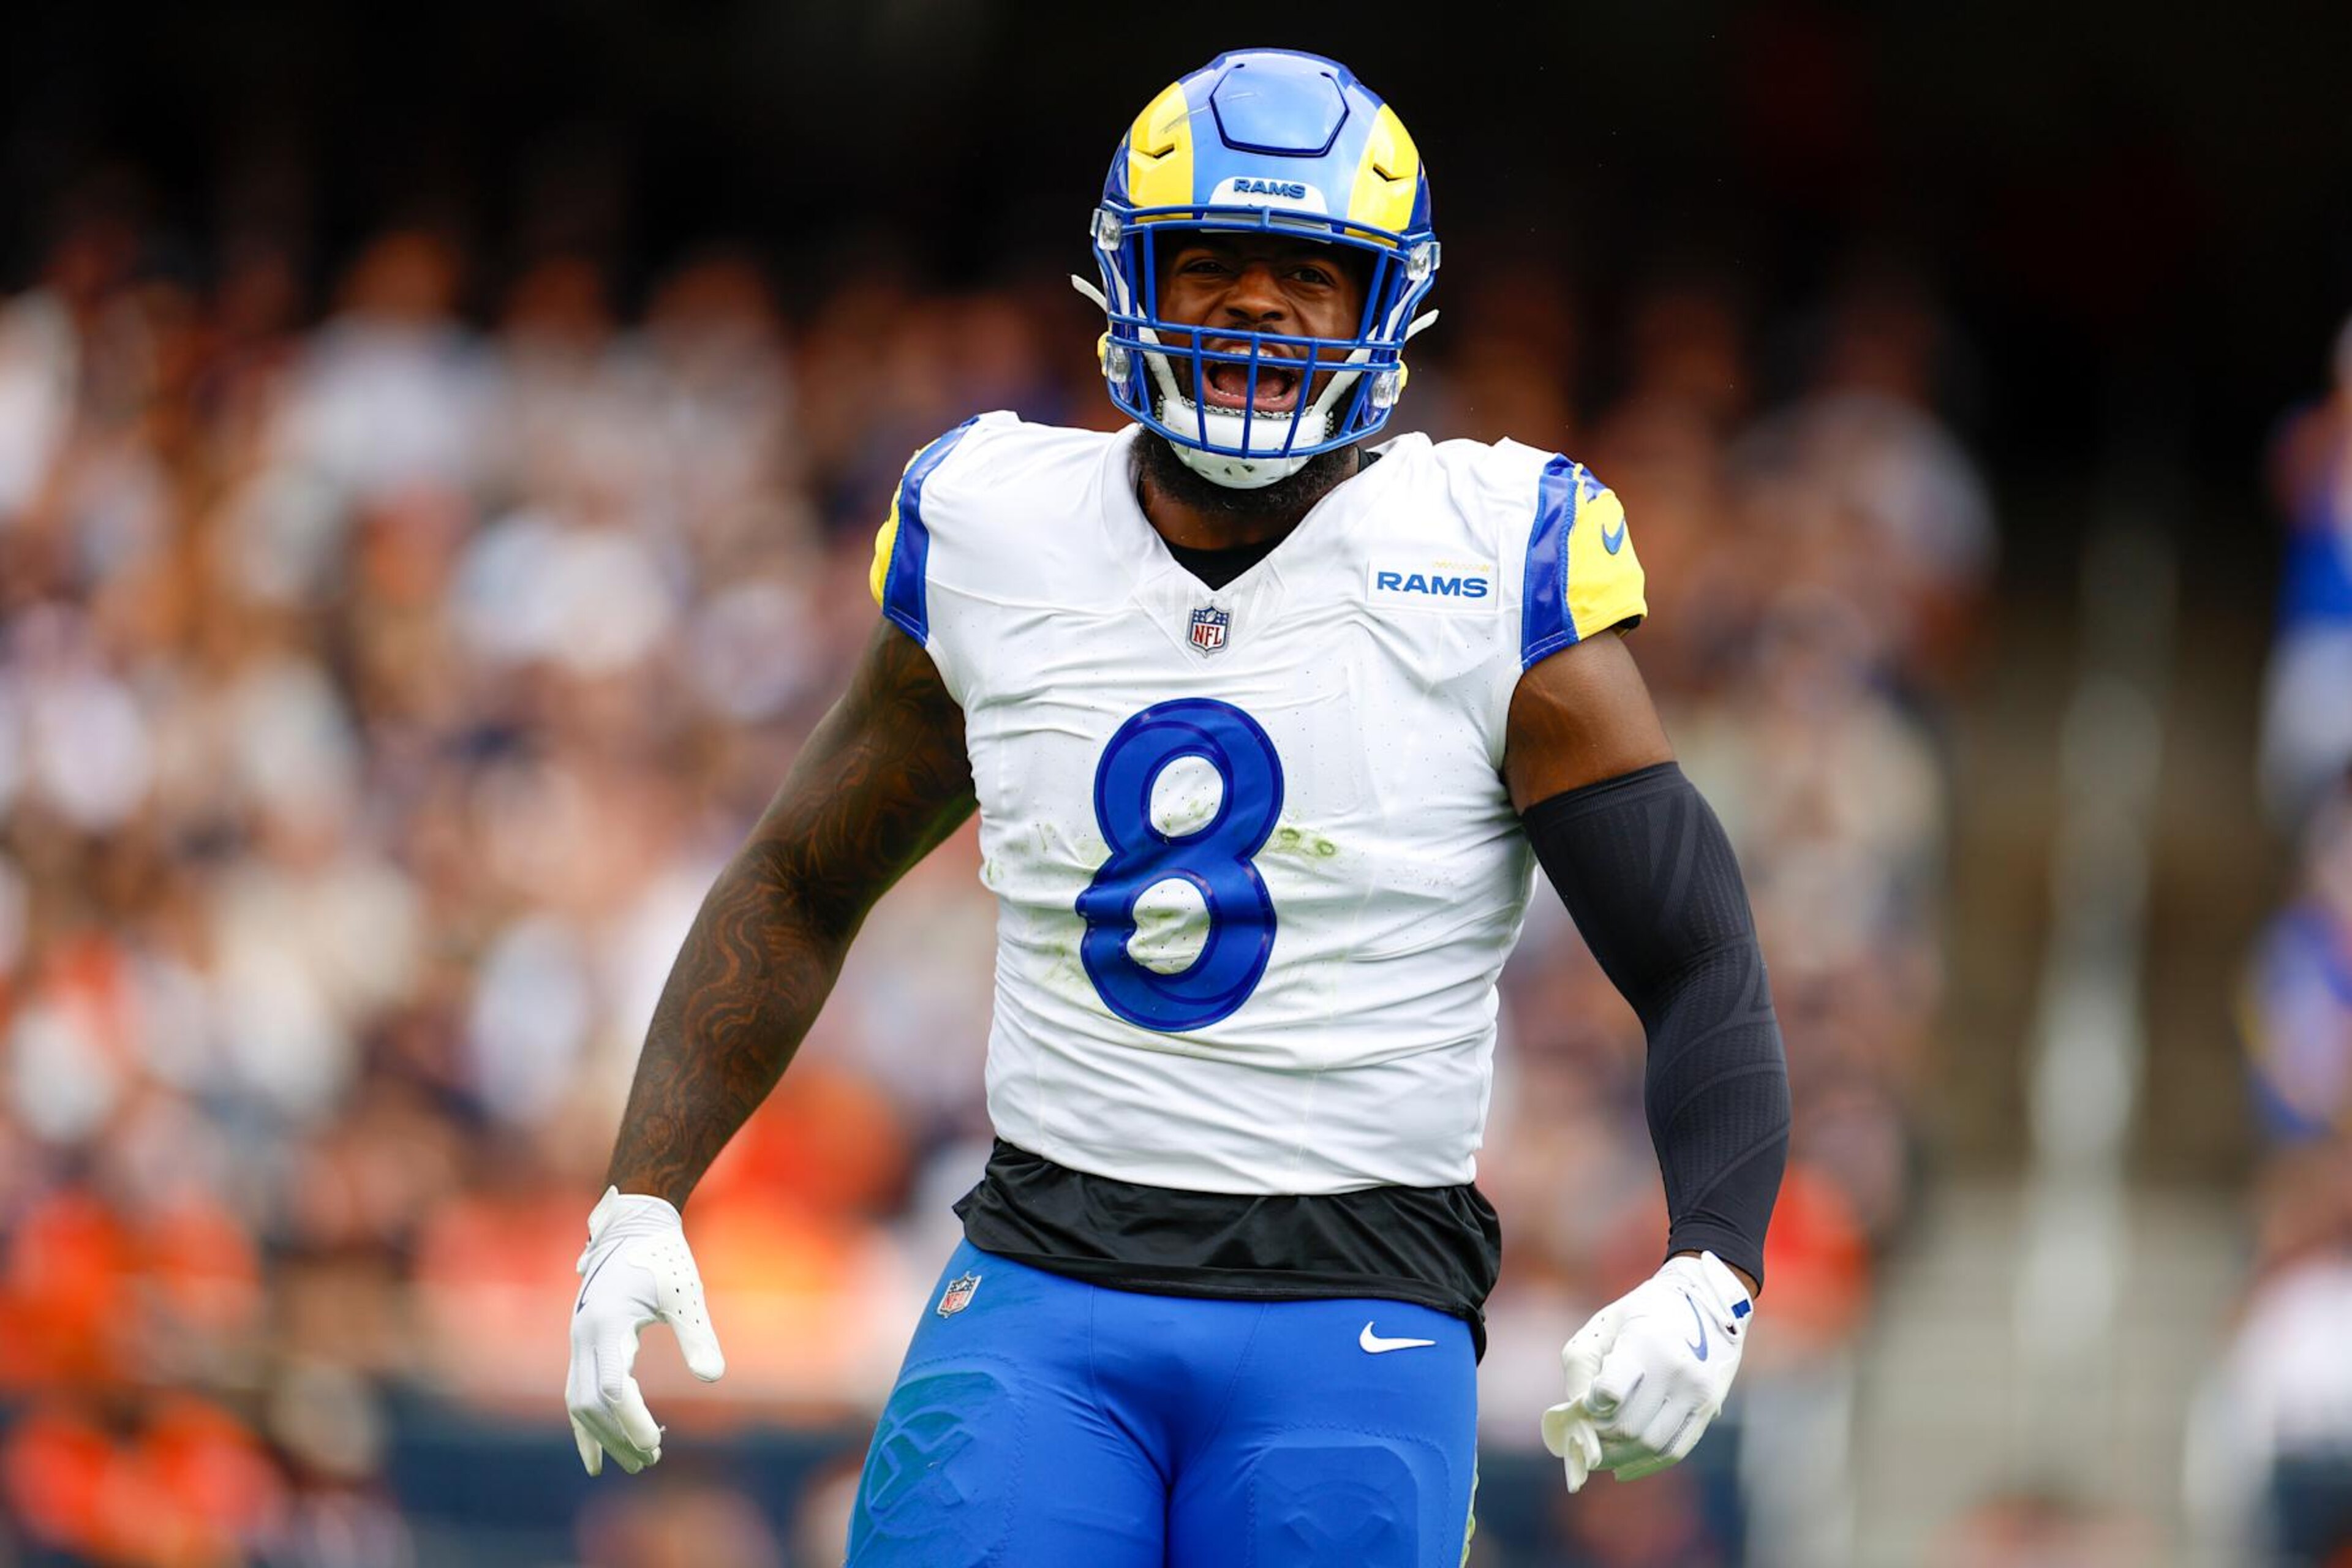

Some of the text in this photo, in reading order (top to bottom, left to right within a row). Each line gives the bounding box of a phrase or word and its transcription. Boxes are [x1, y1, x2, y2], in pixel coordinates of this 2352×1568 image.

[1234, 179, 1306, 199] RAMS
[1377, 571, 1488, 598] RAMS
[1193, 625, 1222, 647] NFL
[1075, 697, 1284, 1032] 8
